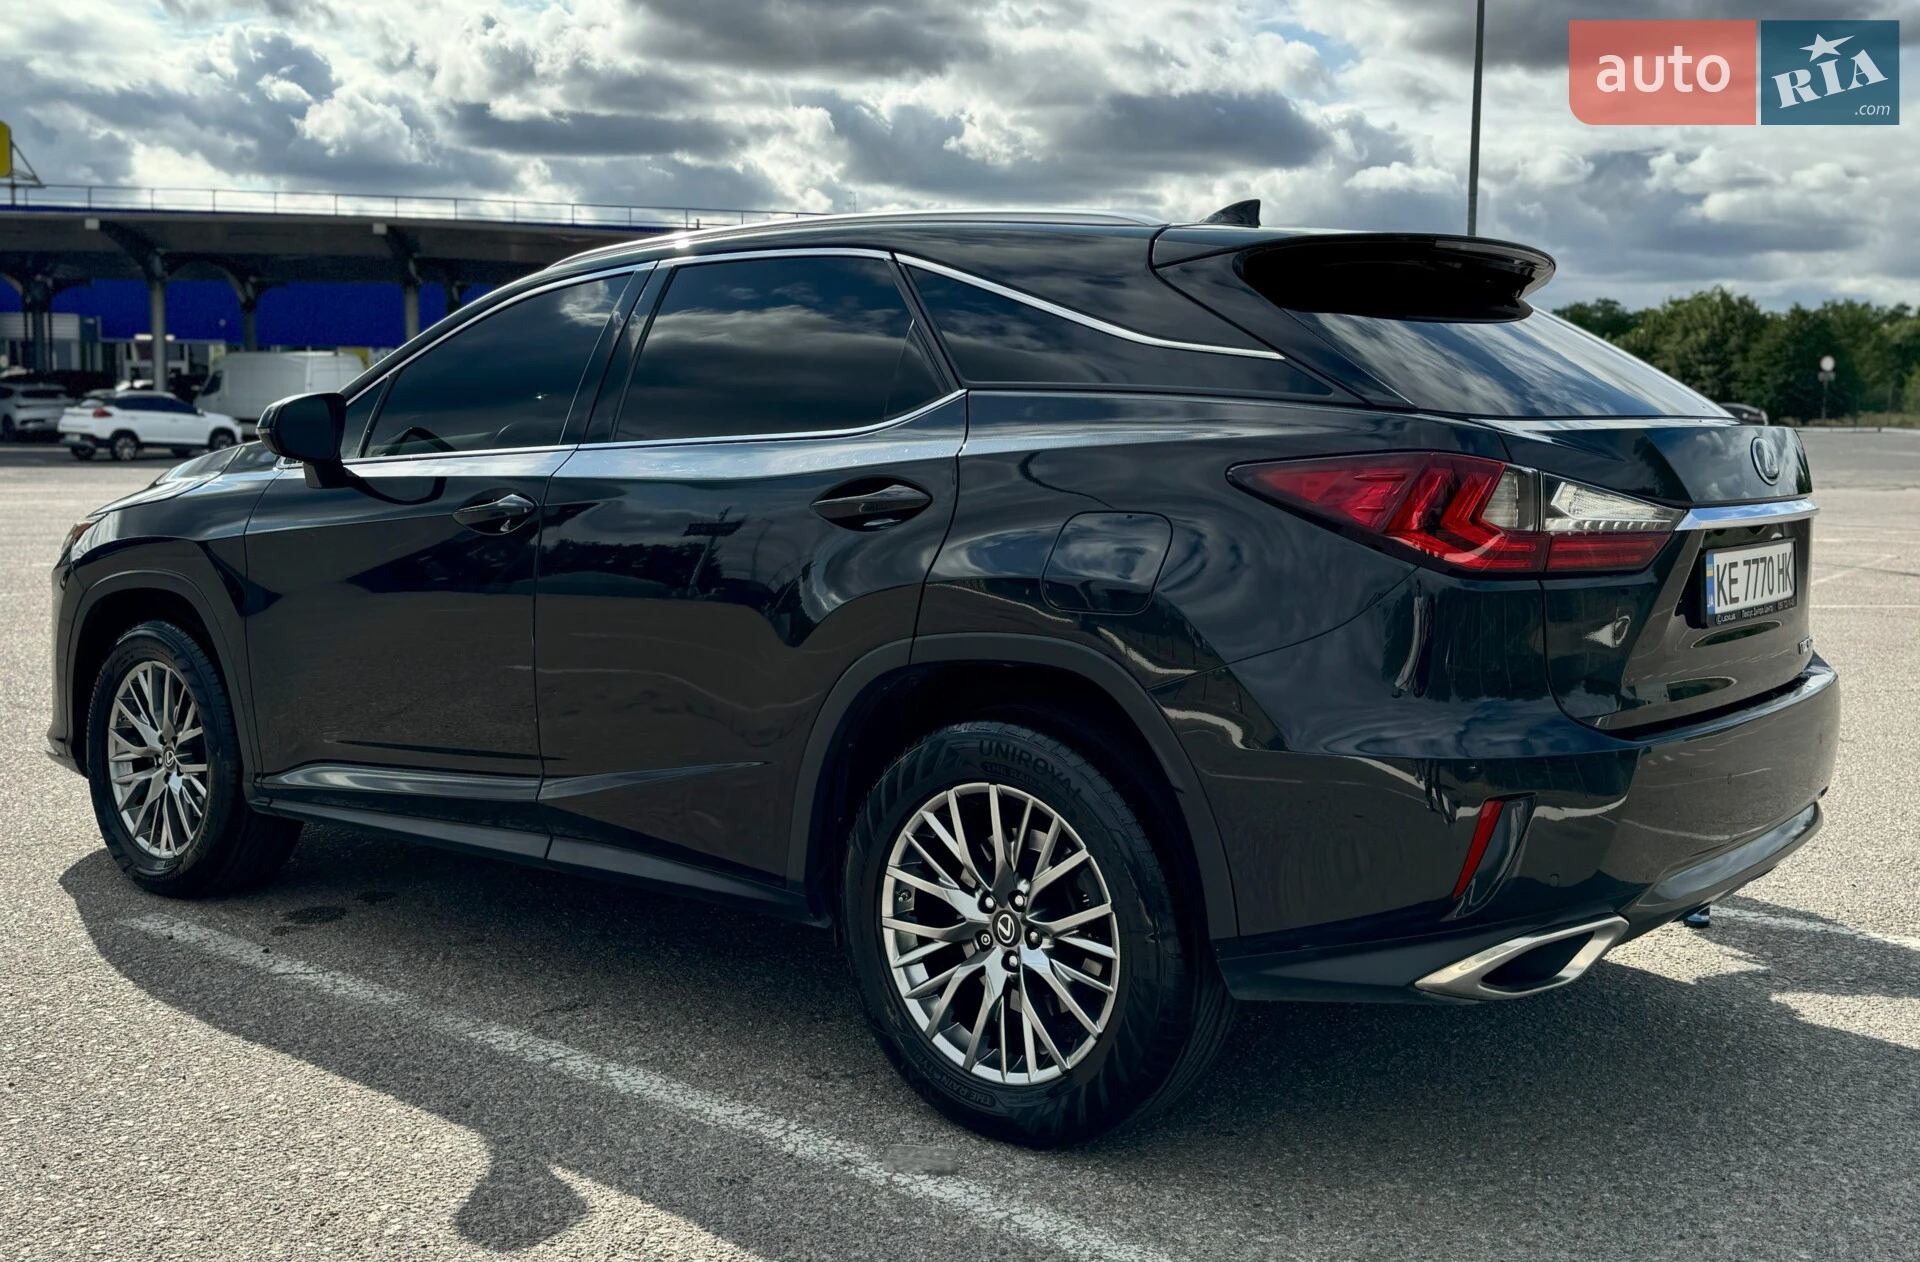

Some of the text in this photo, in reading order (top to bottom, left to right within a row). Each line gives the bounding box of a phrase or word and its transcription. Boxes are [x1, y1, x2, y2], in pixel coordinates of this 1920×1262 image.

[1716, 551, 1793, 607] KE 7770 HK
[979, 740, 1082, 801] UNIROYAL
